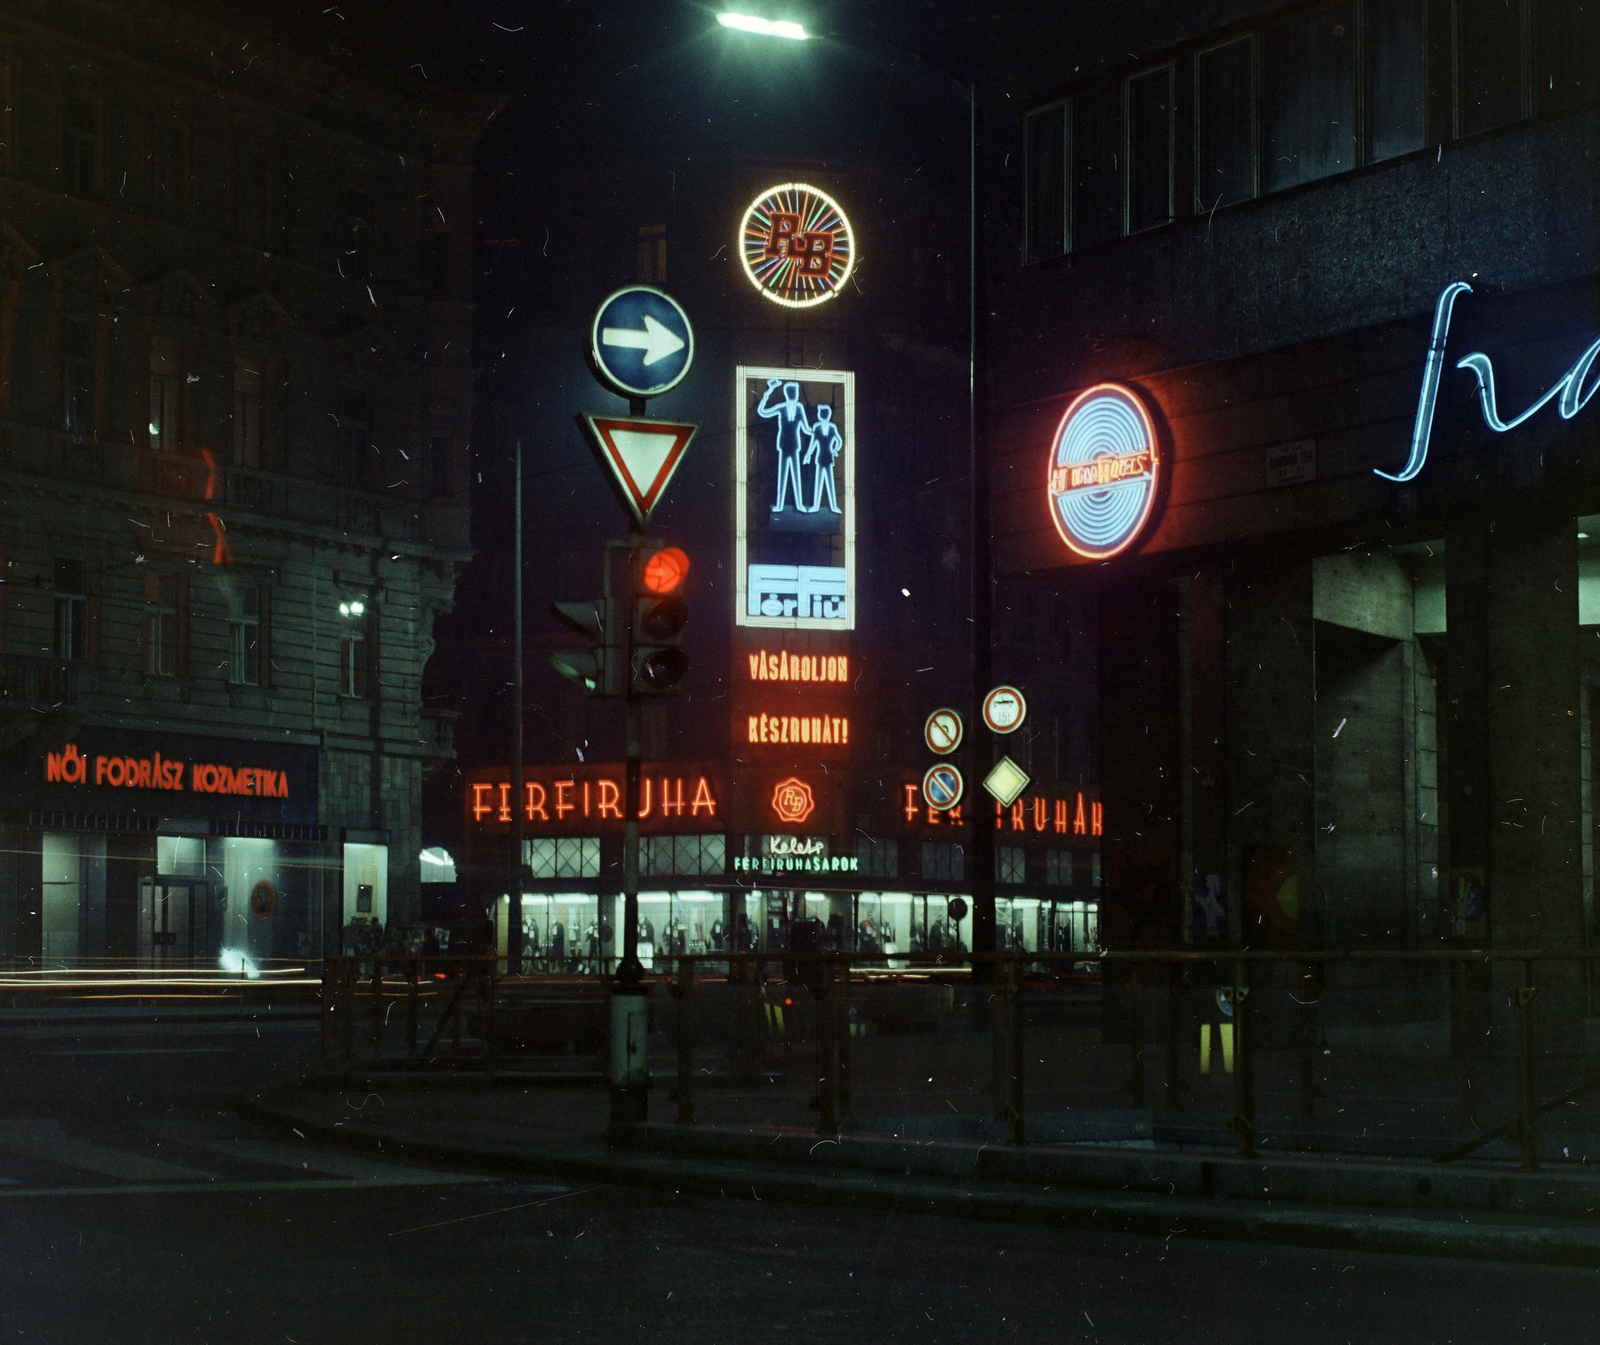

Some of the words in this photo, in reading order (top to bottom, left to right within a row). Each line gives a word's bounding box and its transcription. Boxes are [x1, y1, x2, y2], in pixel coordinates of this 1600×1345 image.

[748, 649, 848, 682] VÁSÁROLJON
[748, 712, 848, 744] KÉSZRUHÁT!
[47, 744, 86, 783] NŐI
[96, 752, 184, 791] FODRÁSZ
[193, 764, 289, 798] KOZMETIKA
